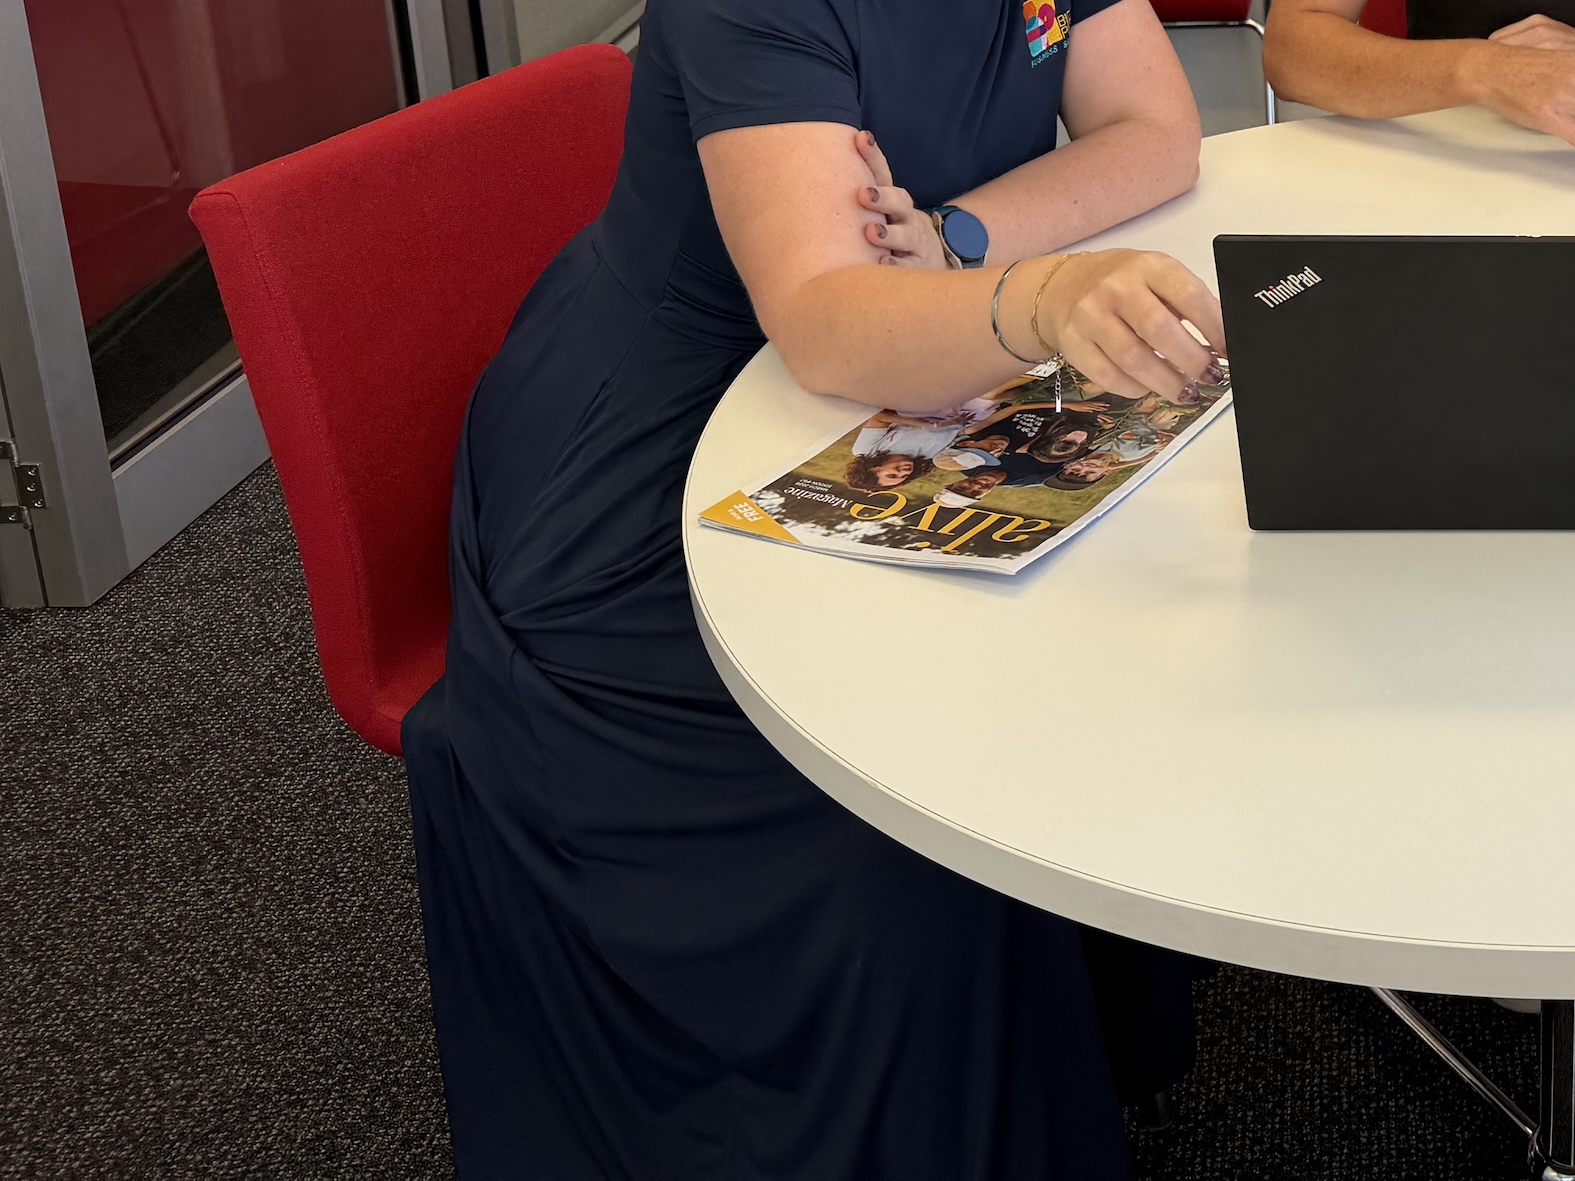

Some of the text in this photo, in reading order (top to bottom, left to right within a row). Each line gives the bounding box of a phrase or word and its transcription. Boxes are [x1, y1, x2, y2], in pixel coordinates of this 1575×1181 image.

[1254, 265, 1322, 308] ThinkPad
[733, 502, 764, 522] FREE
[784, 486, 854, 509] Magazine
[850, 491, 1052, 552] alive
